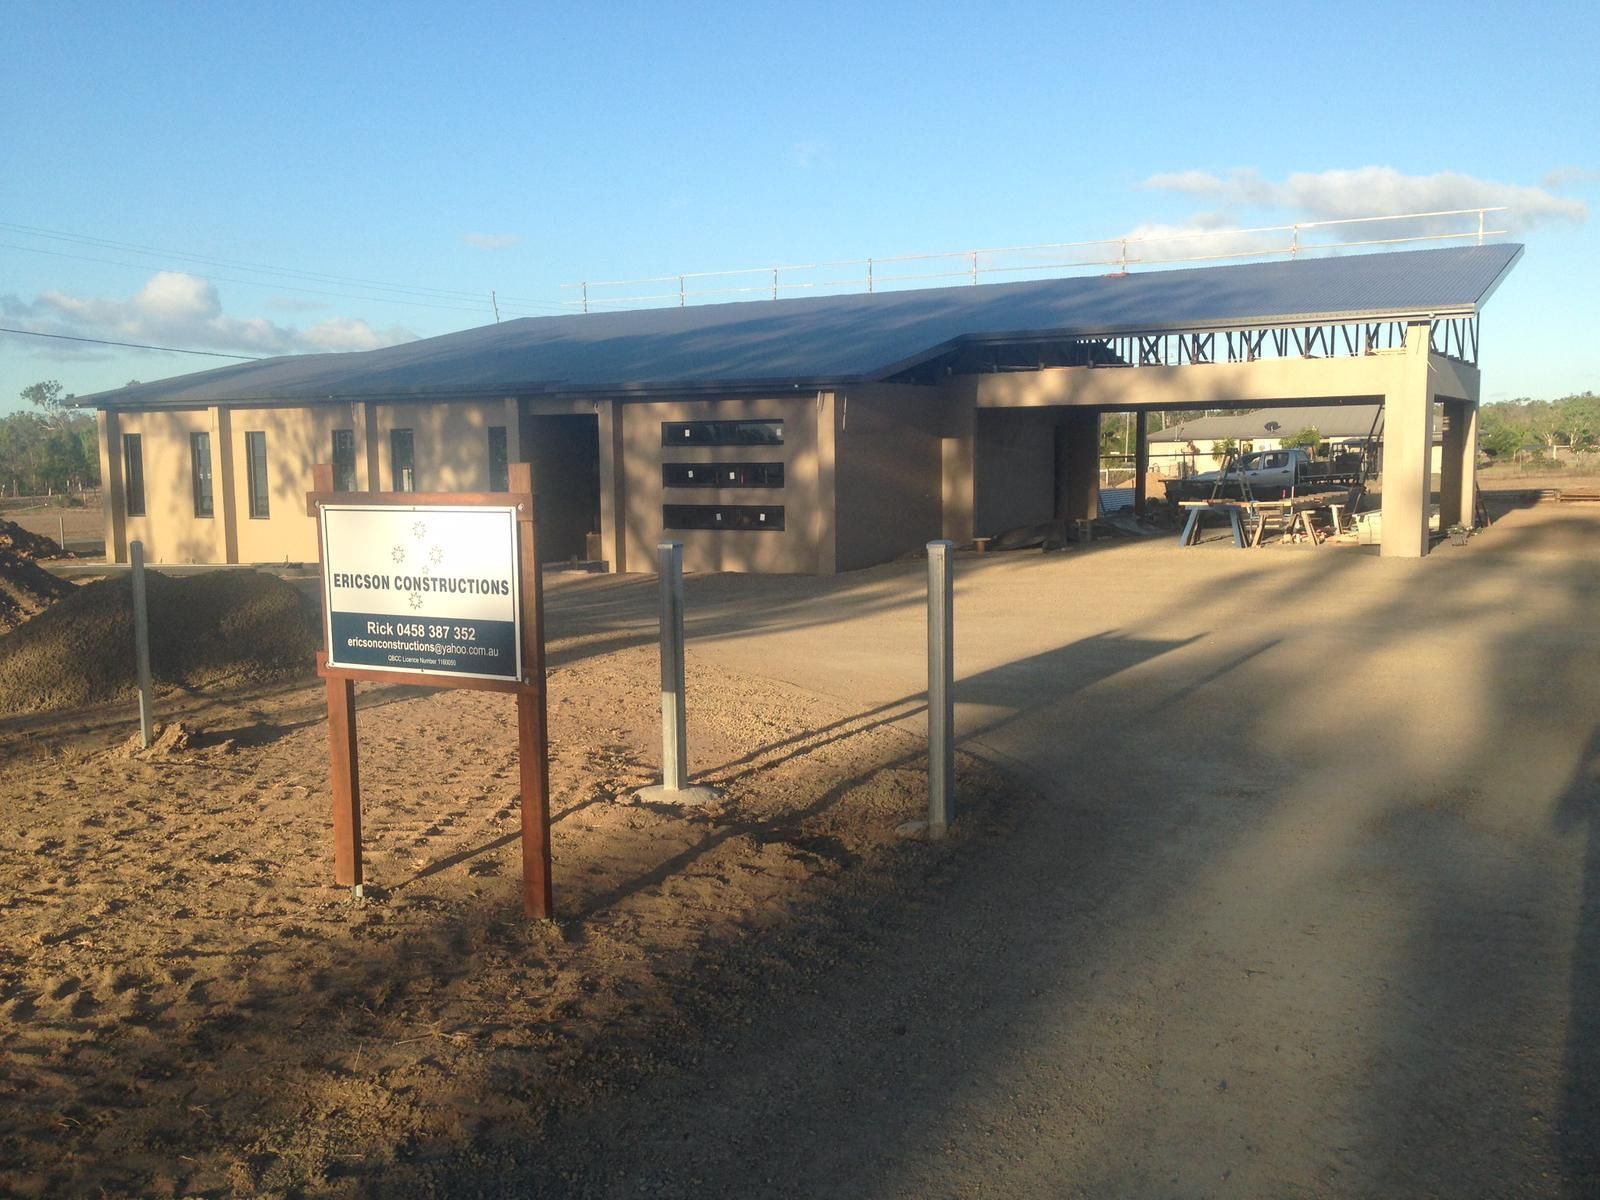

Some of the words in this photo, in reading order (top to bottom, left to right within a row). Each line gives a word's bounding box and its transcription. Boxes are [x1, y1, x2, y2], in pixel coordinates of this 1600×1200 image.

[333, 573, 390, 590] ERICSON
[394, 576, 509, 596] CONSTRUCTIONS
[367, 621, 393, 636] Rick
[396, 623, 425, 638] 0458
[428, 625, 449, 639] 387
[454, 627, 476, 641] 352
[347, 636, 499, 657] ericsonconstructions@yahoo.com.au
[420, 657, 437, 665] Number
